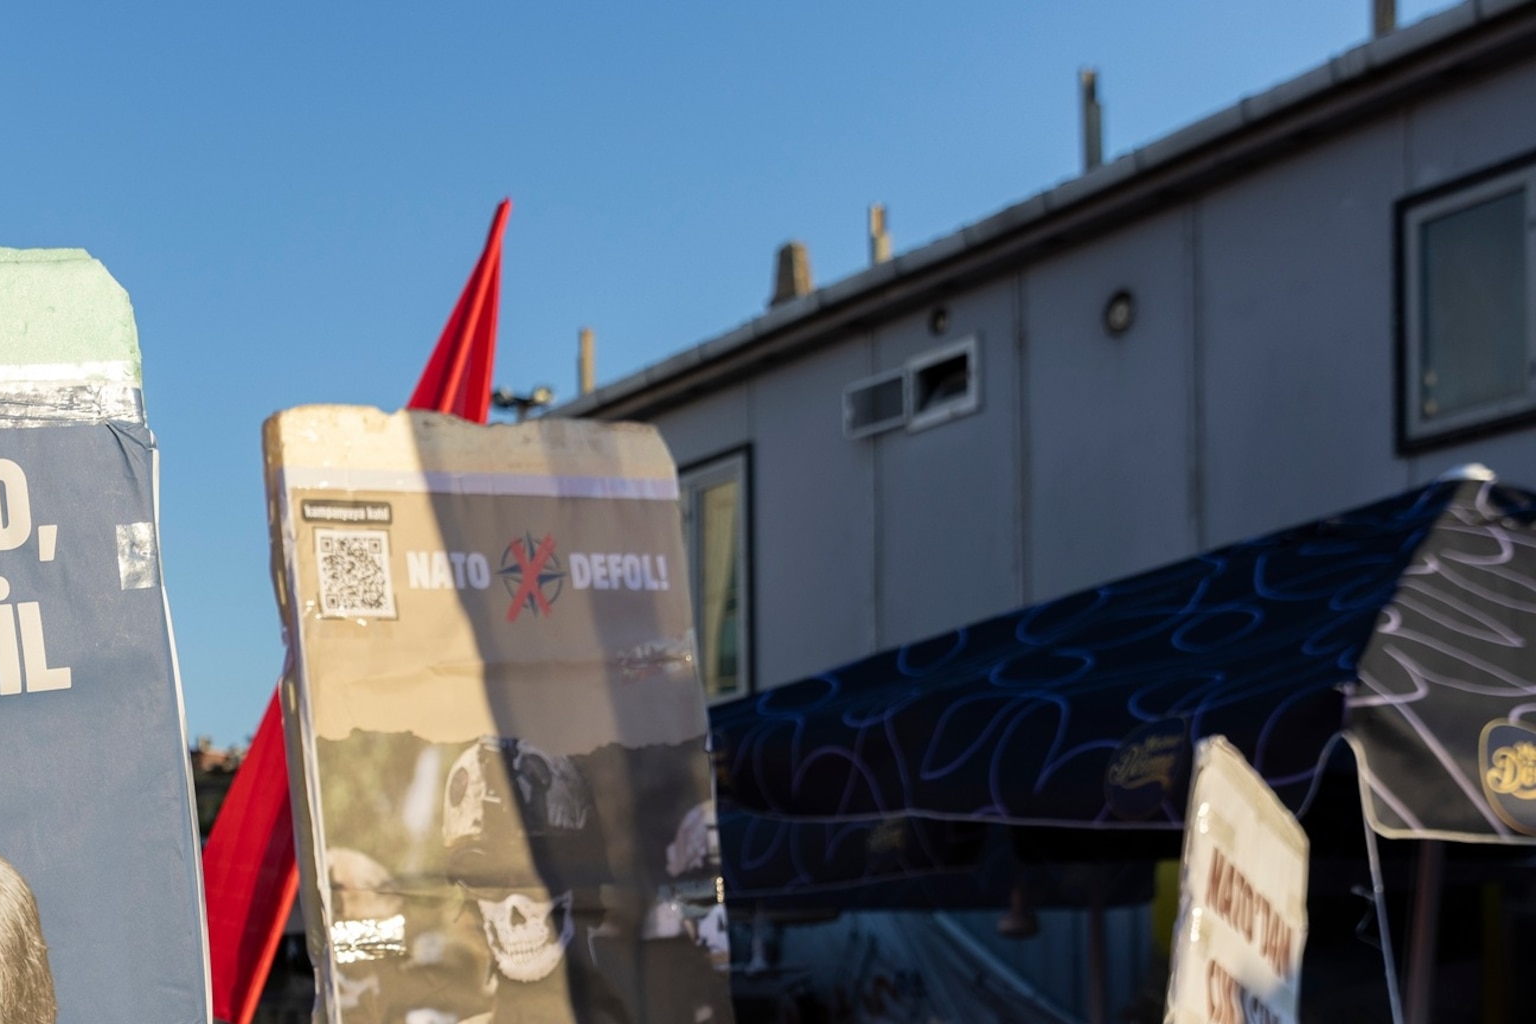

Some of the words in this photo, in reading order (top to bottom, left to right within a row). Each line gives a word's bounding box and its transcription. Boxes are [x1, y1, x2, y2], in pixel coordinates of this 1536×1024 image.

[405, 550, 491, 590] NATO
[568, 551, 670, 591] DEFOL!
[1205, 846, 1292, 981] NATO'DAN
